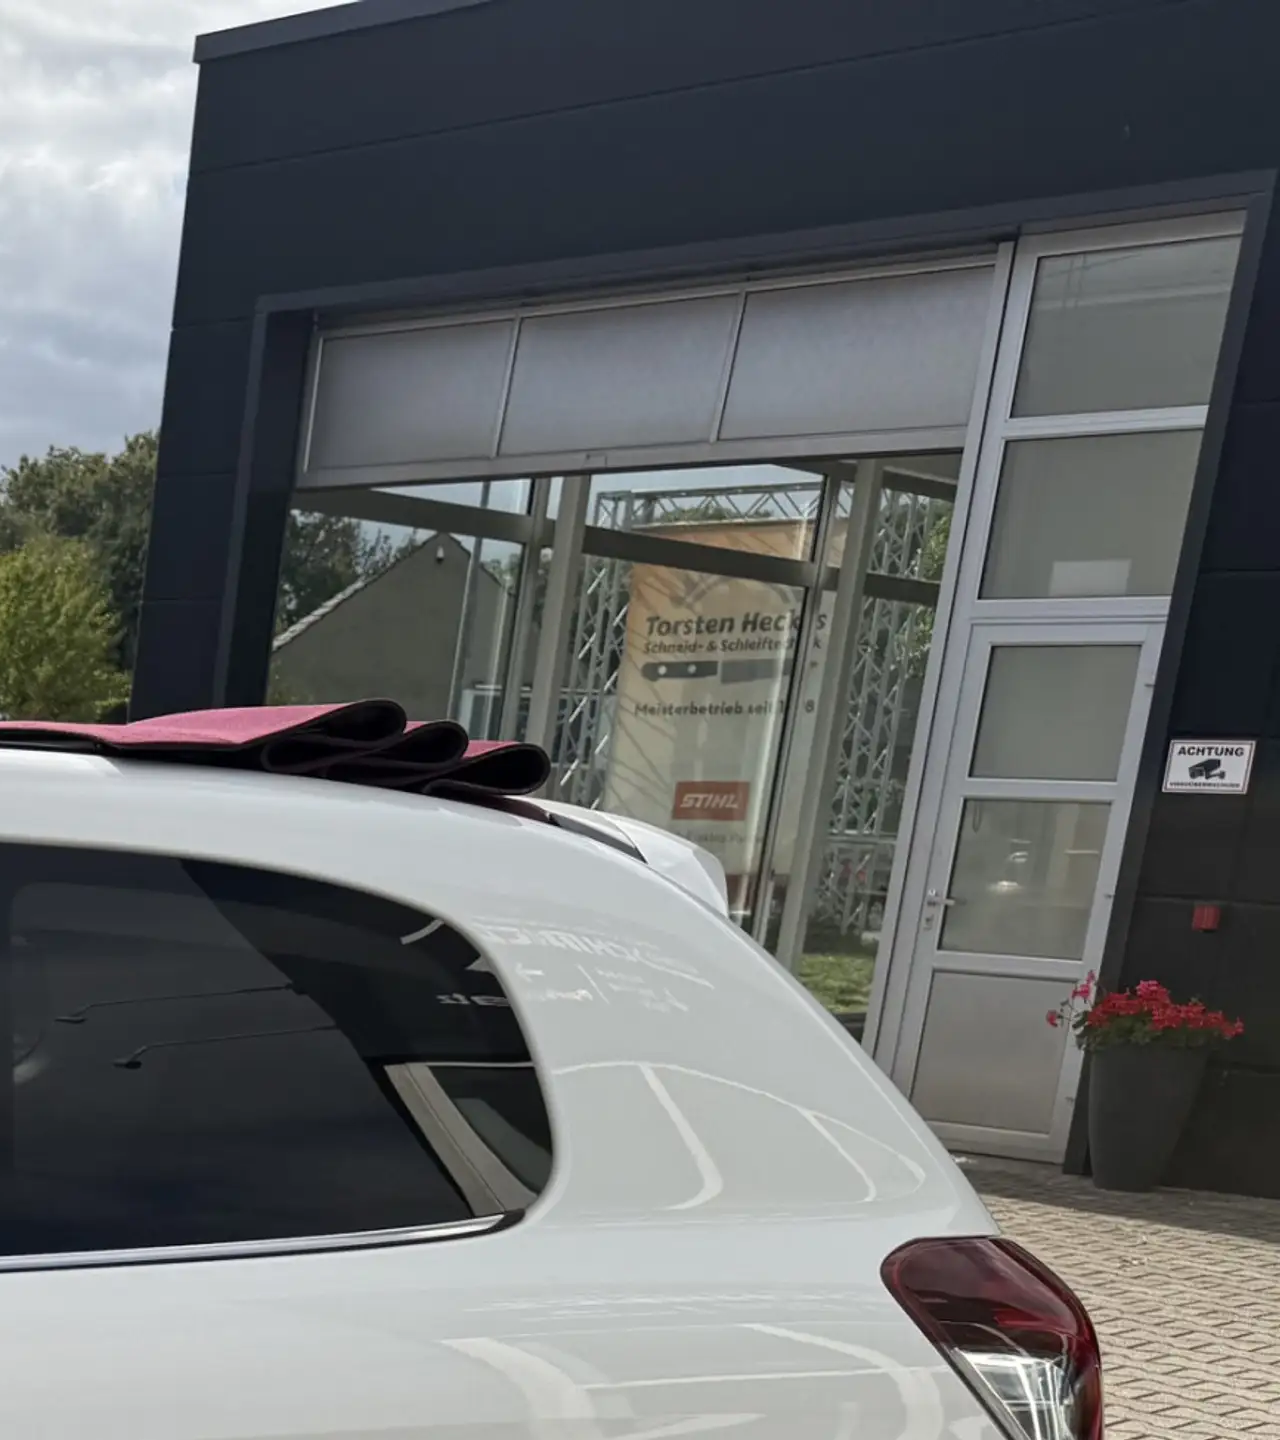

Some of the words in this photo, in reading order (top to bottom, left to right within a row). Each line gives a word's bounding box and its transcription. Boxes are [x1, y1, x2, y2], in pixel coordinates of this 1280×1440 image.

[646, 614, 735, 636] Torsten
[705, 640, 717, 652] &
[635, 701, 743, 717] Meisterbetrieb
[1178, 746, 1245, 757] ACHTUNG
[680, 793, 739, 809] STIHL
